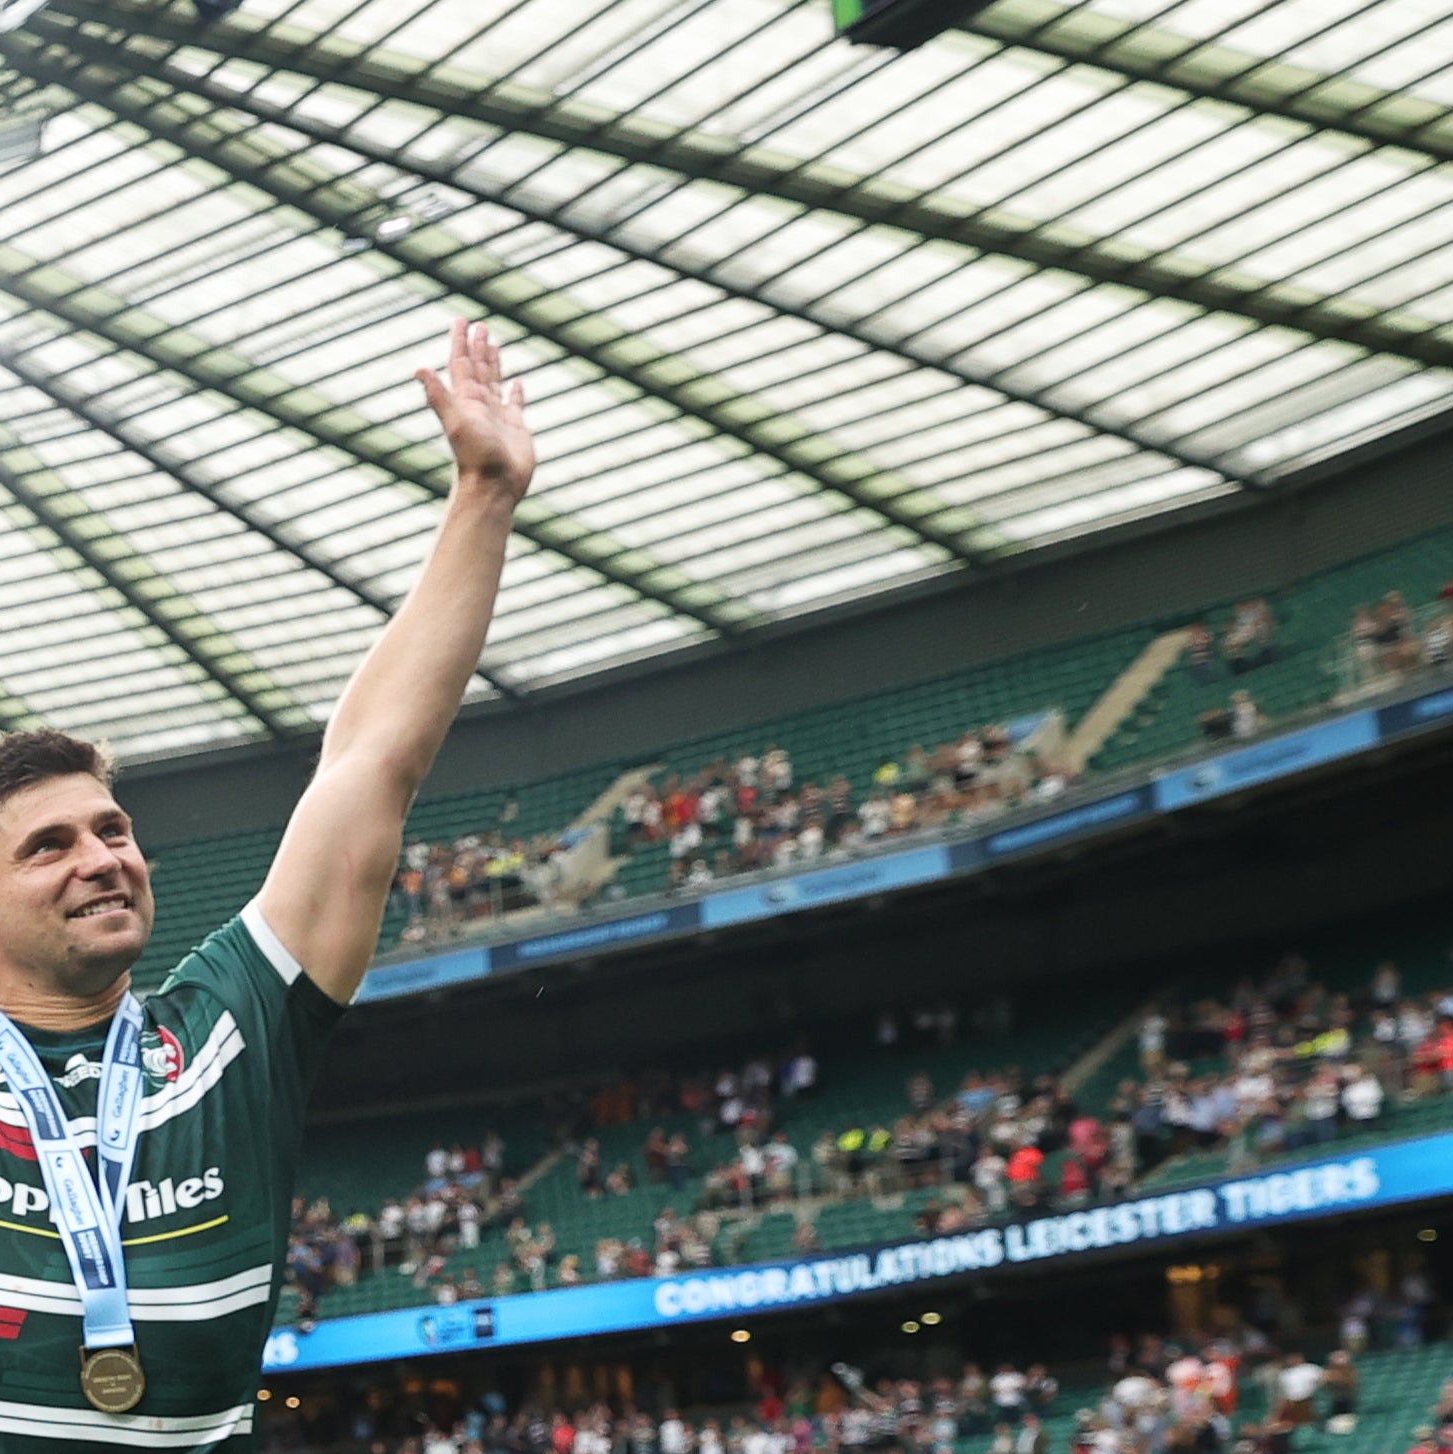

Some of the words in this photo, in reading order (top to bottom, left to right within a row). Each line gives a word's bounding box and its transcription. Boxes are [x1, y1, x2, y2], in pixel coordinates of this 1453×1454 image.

[126, 1166, 225, 1224] Tiles
[654, 1227, 1004, 1317] CONGRATULATIONS
[1004, 1187, 1220, 1263] LEICESTER
[1220, 1156, 1382, 1223] TIGERS
